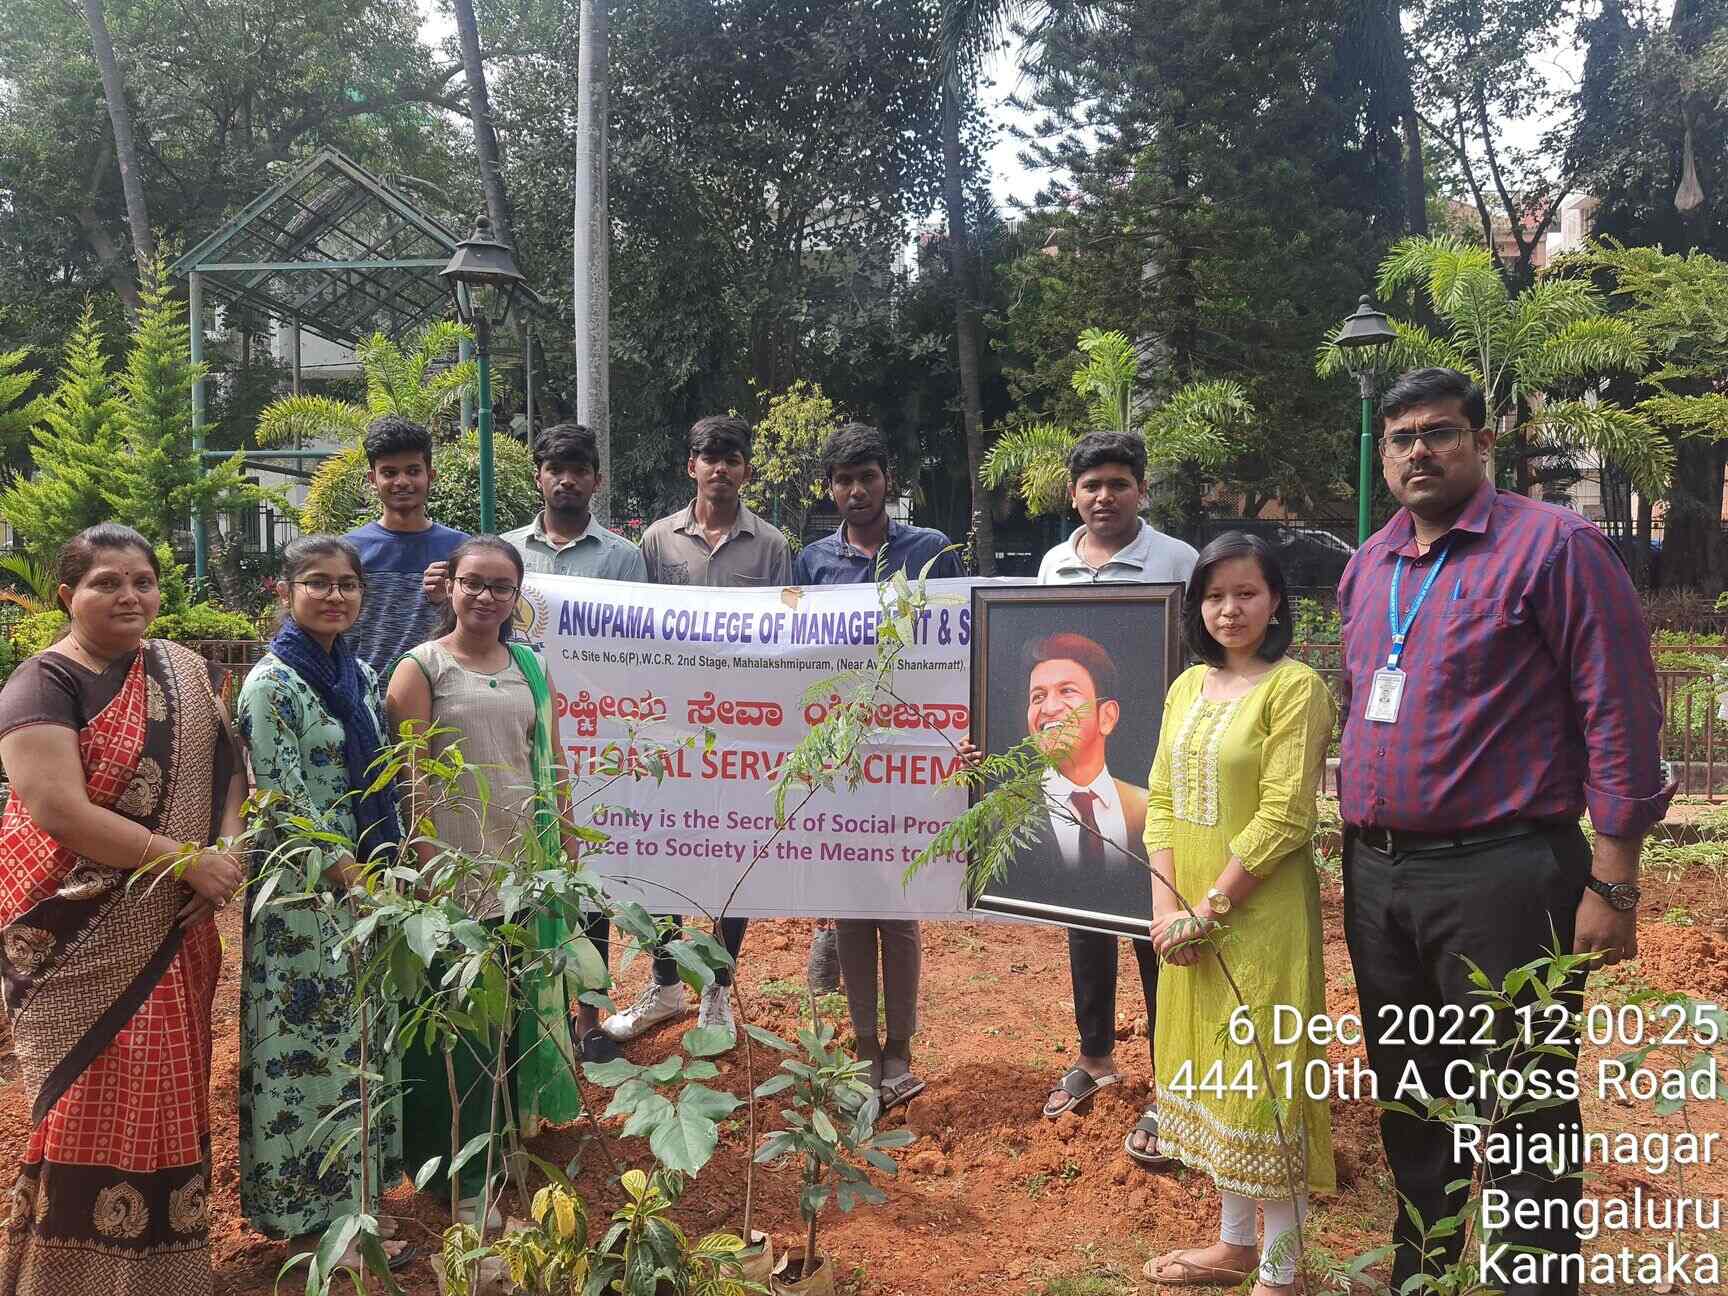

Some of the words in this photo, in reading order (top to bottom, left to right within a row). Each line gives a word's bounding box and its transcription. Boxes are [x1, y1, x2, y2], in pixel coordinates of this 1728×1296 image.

[558, 600, 656, 639] ANUPAMA
[661, 609, 754, 644] COLLEGE
[759, 613, 787, 645] OF
[790, 611, 932, 646] MANAGENT
[938, 609, 952, 645] &
[581, 650, 600, 663] Site
[677, 655, 696, 667] 2nd
[699, 656, 730, 670] Stage,
[733, 658, 834, 672] Mahalakshmipuram,
[836, 659, 865, 672] (Near
[688, 691, 783, 727] ಸೇವಾ
[593, 808, 653, 832] Unity
[660, 809, 677, 828] is
[683, 809, 720, 830] the
[802, 813, 826, 832] of
[832, 815, 896, 834] Social
[636, 839, 658, 856] to
[665, 838, 746, 863] Society
[752, 841, 769, 859] is
[776, 841, 813, 860] the
[820, 843, 895, 863] Means
[901, 845, 924, 863] to
